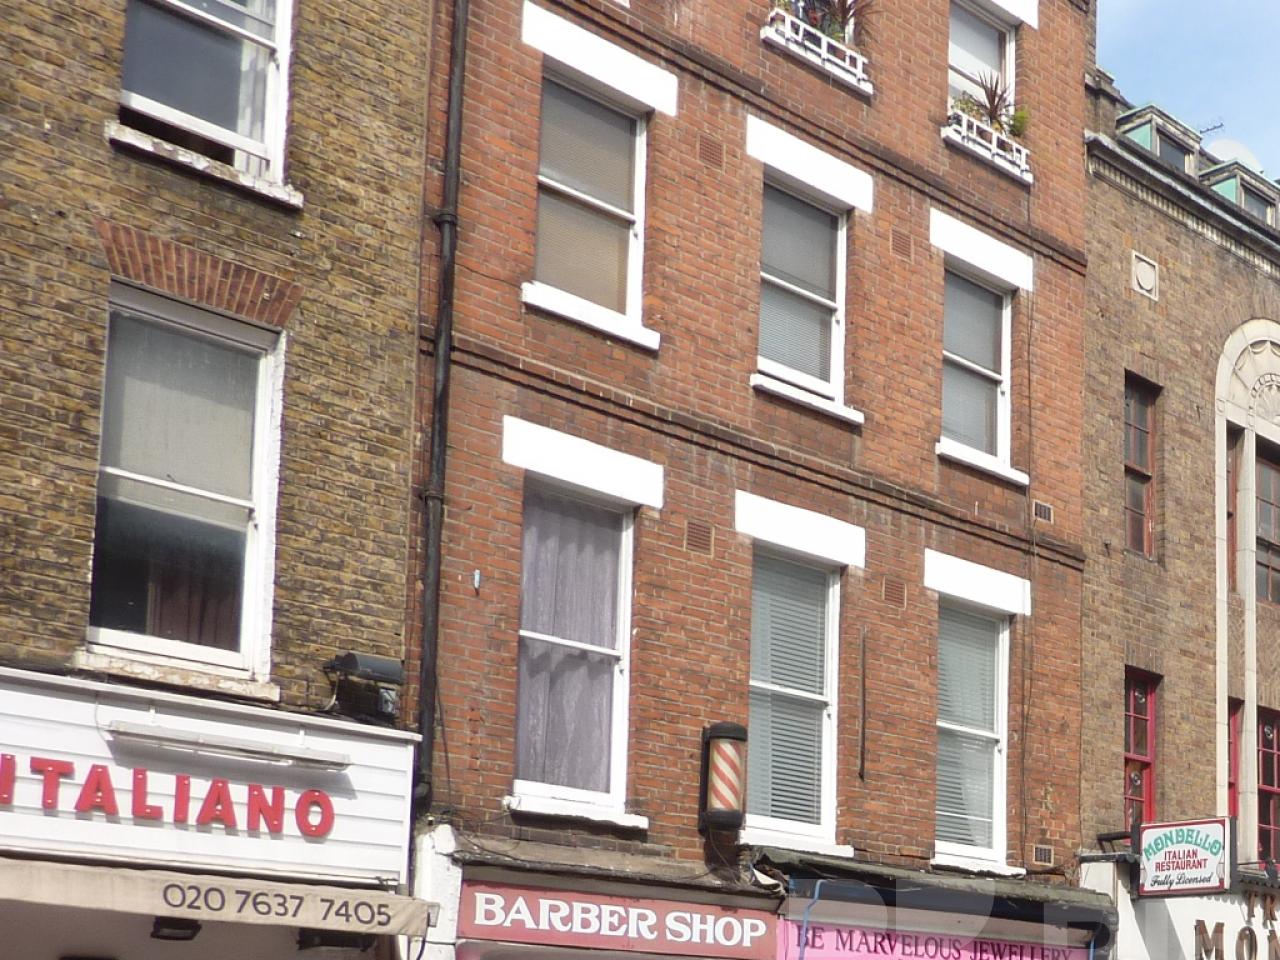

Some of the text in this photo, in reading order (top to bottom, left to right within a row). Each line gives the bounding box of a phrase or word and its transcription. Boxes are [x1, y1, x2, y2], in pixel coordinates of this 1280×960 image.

[0, 753, 335, 838] ITALIANO
[1143, 828, 1222, 861] MONDELLO
[1164, 849, 1198, 861] ITALIAN
[1150, 872, 1214, 887] Fully Licensed
[1155, 858, 1208, 872] RESTAURANT
[162, 883, 392, 927] 020 7637 7405
[474, 892, 767, 947] BARBER SHOP
[796, 925, 824, 949] BE
[836, 928, 961, 960] MARVELOUS
